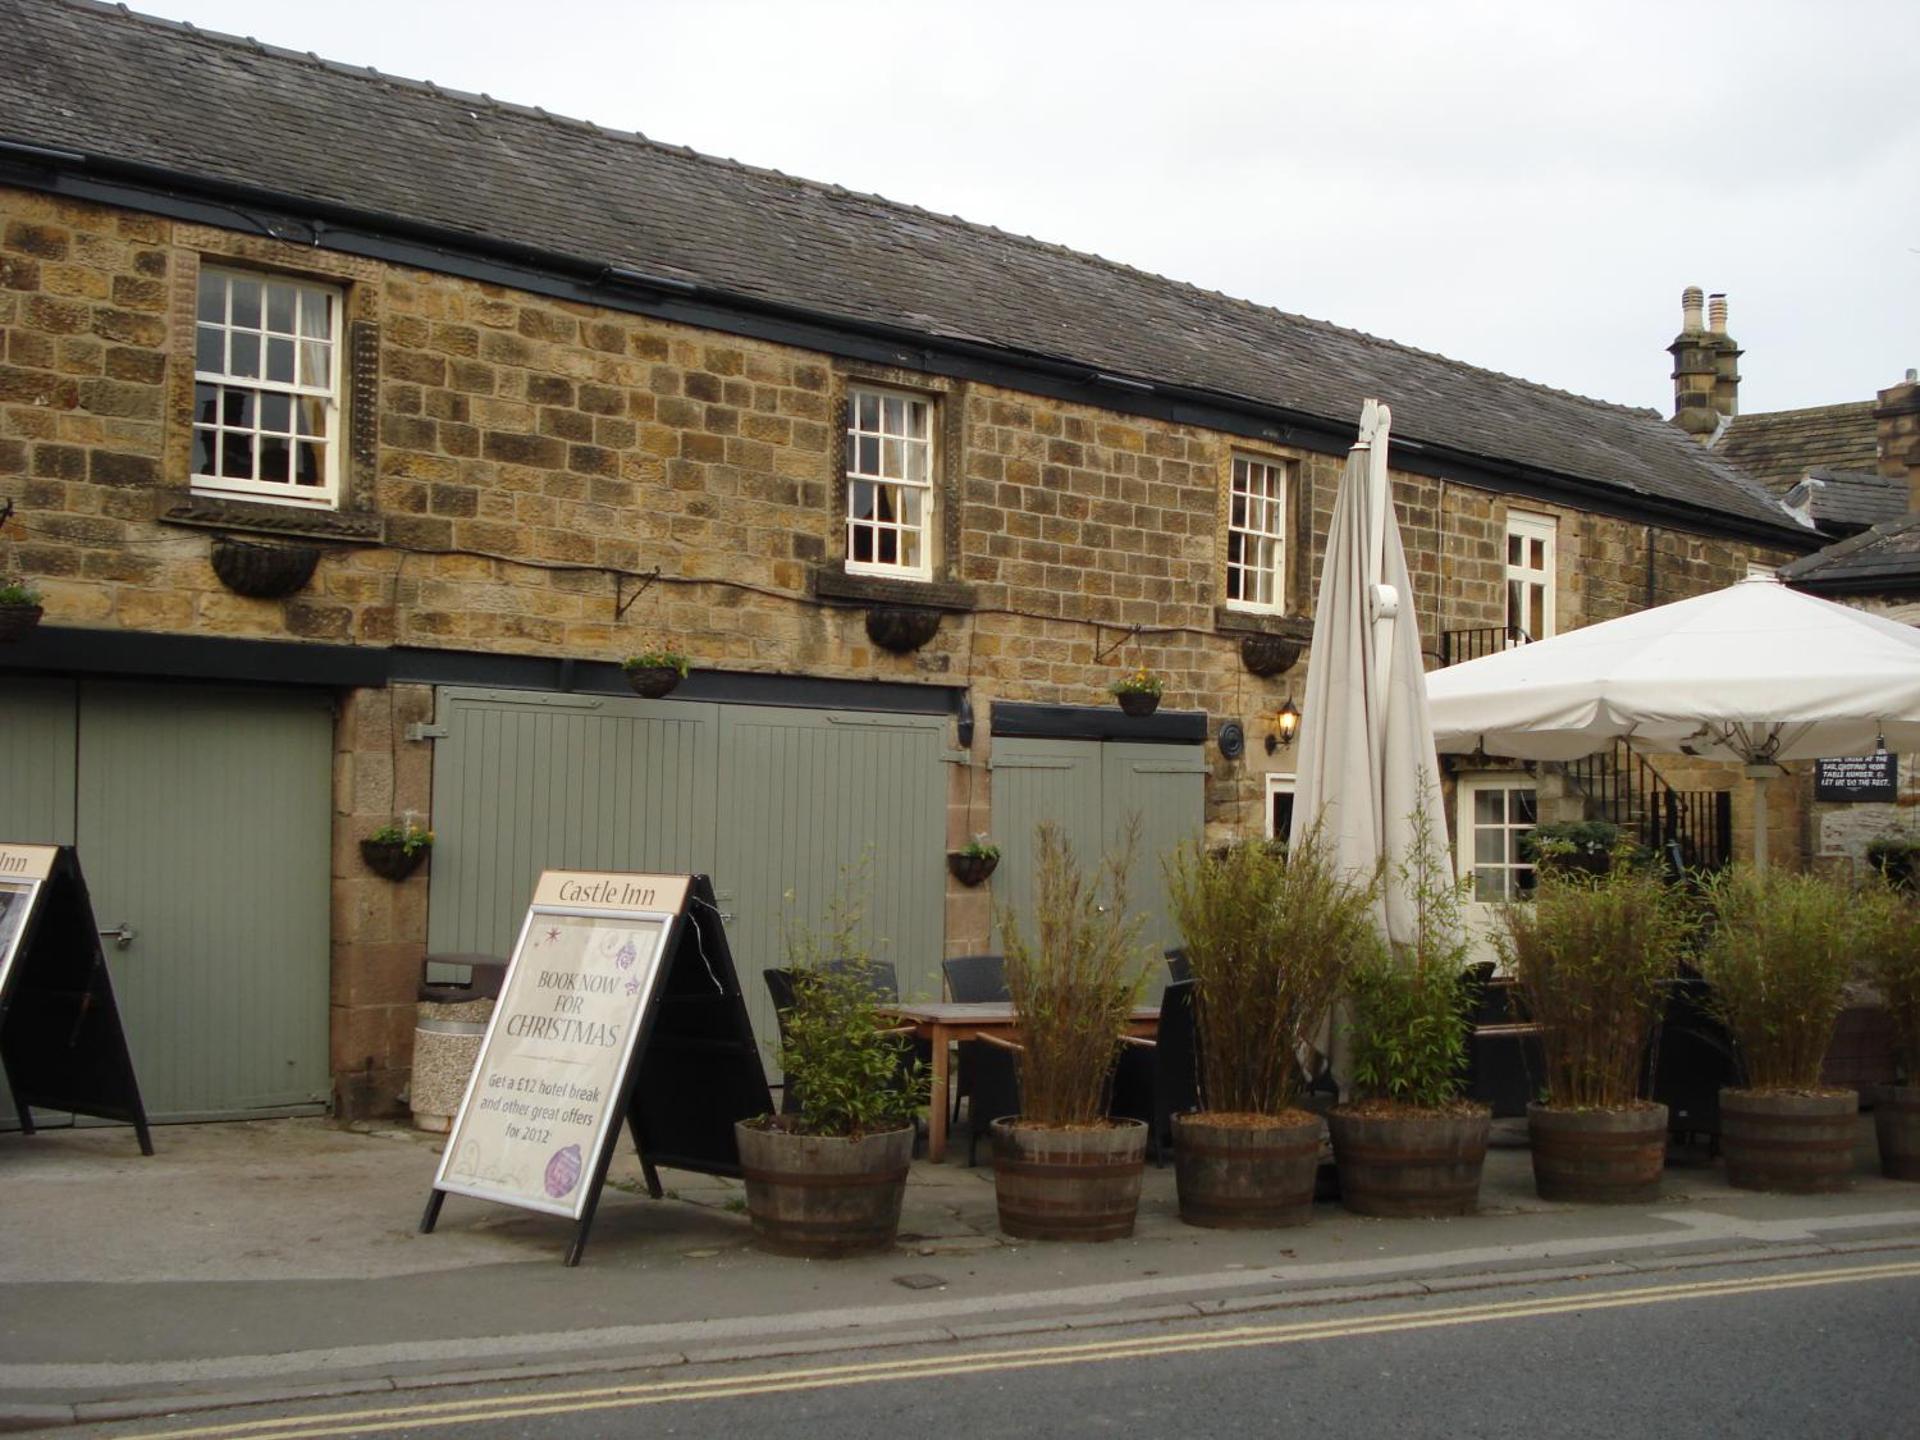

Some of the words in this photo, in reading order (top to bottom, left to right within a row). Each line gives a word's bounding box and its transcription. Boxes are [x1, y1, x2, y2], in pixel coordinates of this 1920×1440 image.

[559, 880, 617, 903] Castle
[620, 883, 656, 906] Inn
[537, 970, 580, 991] BOOK
[578, 973, 622, 994] NOW
[553, 994, 585, 1015] FOR
[507, 1014, 622, 1048] CHRISTMAS
[488, 1073, 506, 1088] Get
[507, 1077, 515, 1088] a
[516, 1077, 537, 1094] £12
[538, 1079, 568, 1097] hotel
[569, 1082, 600, 1103] break
[480, 1097, 502, 1111] and
[502, 1098, 530, 1116] other
[531, 1106, 558, 1121] great
[561, 1108, 593, 1127] offers
[505, 1122, 520, 1138] for
